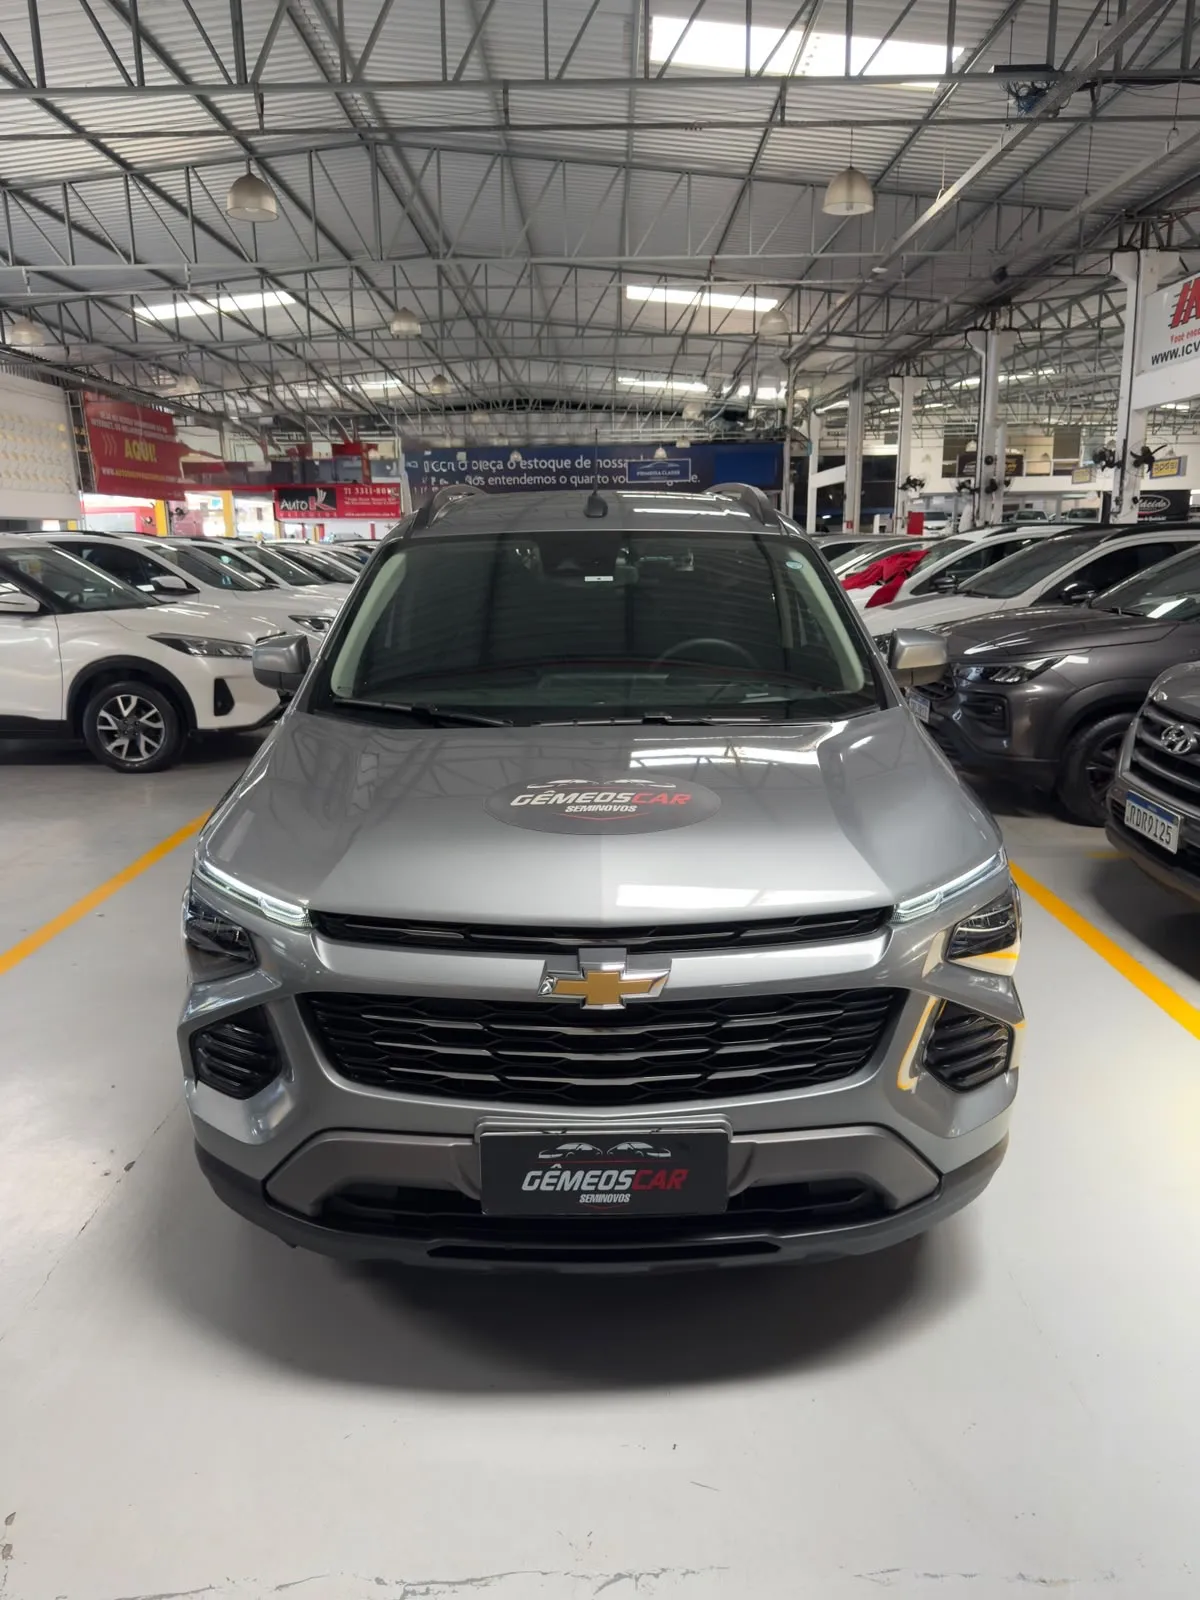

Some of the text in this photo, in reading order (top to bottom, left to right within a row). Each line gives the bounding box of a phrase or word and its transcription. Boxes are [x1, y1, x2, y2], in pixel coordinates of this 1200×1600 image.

[520, 457, 571, 473] estoque
[575, 454, 591, 469] de
[488, 472, 557, 485] entendemos
[559, 475, 567, 484] o
[510, 790, 692, 806] GÊMEOSCAR
[565, 805, 638, 813] SEMINOVOS
[521, 1164, 688, 1191] GÊMEOSCAR
[579, 1193, 631, 1204] SEMINOVOS
